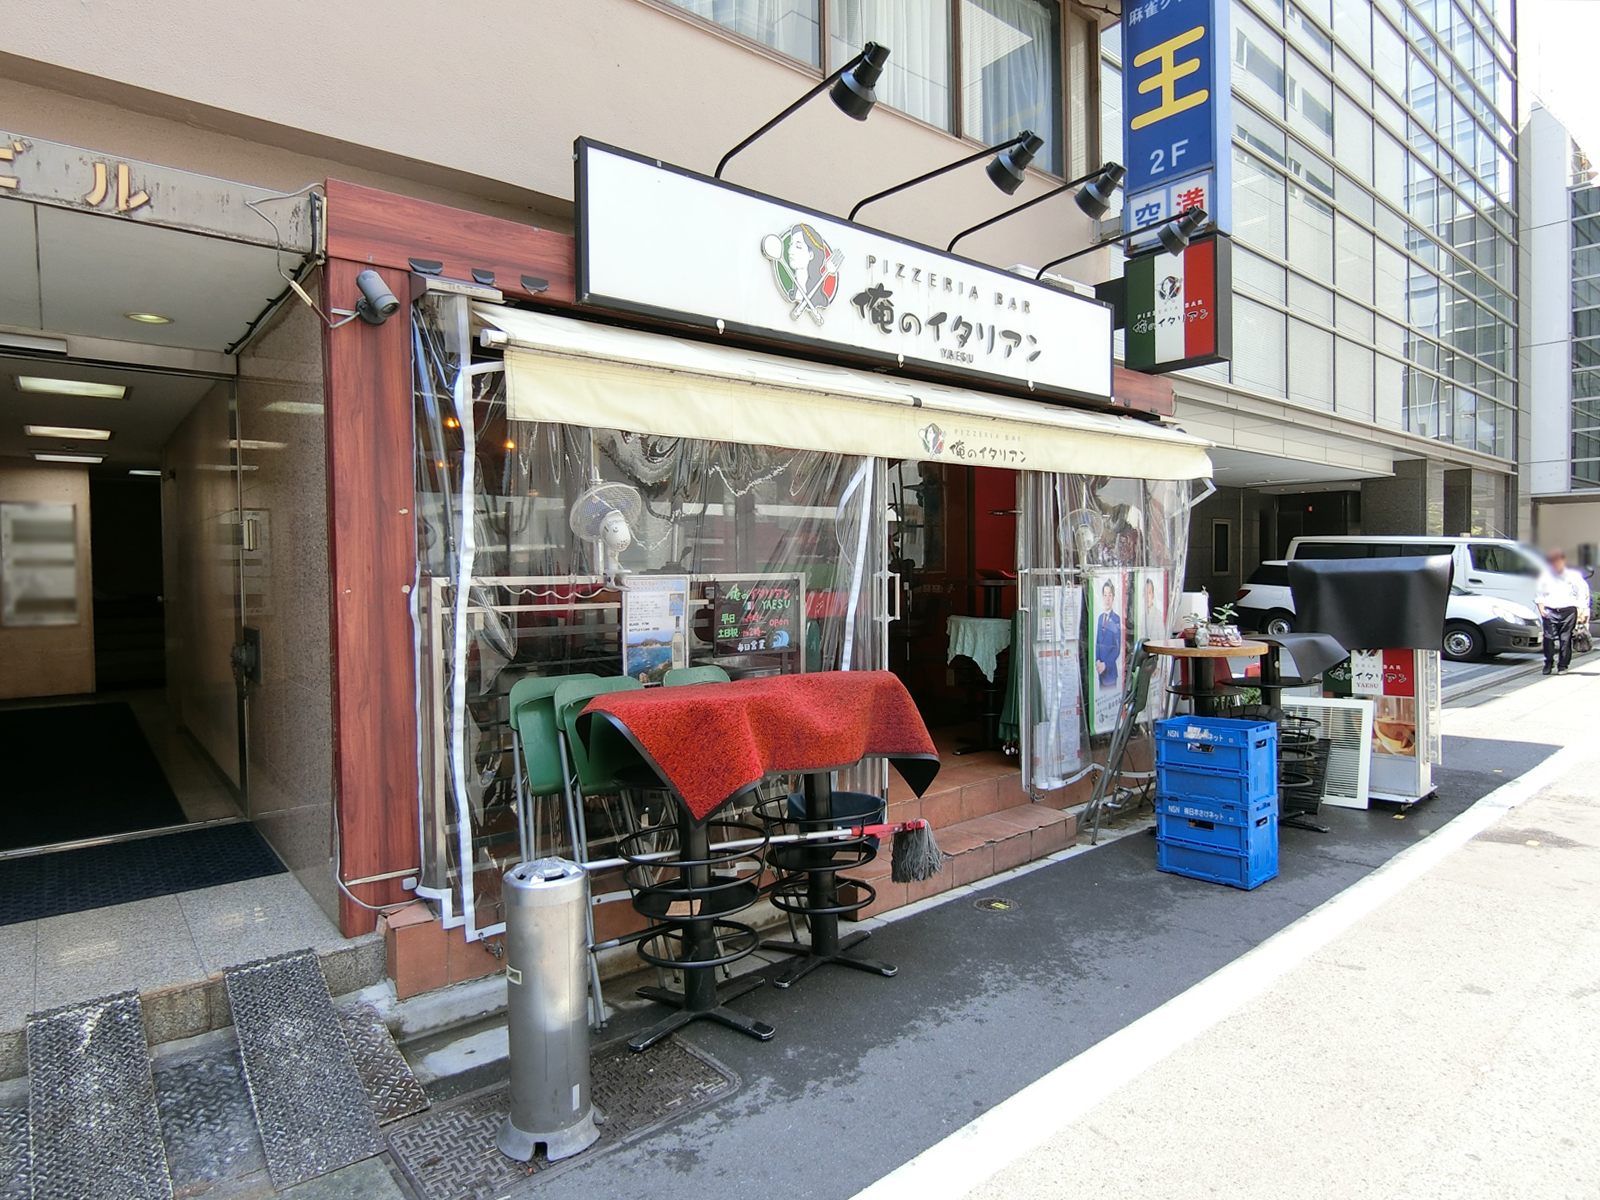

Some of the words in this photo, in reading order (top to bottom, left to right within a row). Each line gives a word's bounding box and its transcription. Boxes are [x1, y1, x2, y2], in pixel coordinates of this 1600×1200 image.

[1129, 0, 1181, 27] 麻雀ク
[1131, 25, 1209, 130] 王
[1150, 139, 1188, 175] 2F
[866, 254, 979, 300] PIZZERIA
[994, 291, 1031, 315] BAR
[1132, 308, 1208, 334] 俺のイタリアン
[1137, 306, 1178, 320] PIZZERIA
[1185, 299, 1203, 309] BAR
[850, 282, 1042, 364] 俺のイタリアン
[940, 347, 974, 364] YAESU
[954, 429, 1000, 440] PIZZERIA
[1005, 433, 1021, 442] BAR
[949, 440, 1027, 463] 俺のイタリアン
[762, 599, 791, 610] YAESU
[1167, 730, 1179, 738] NSN
[1168, 805, 1180, 813] NSN
